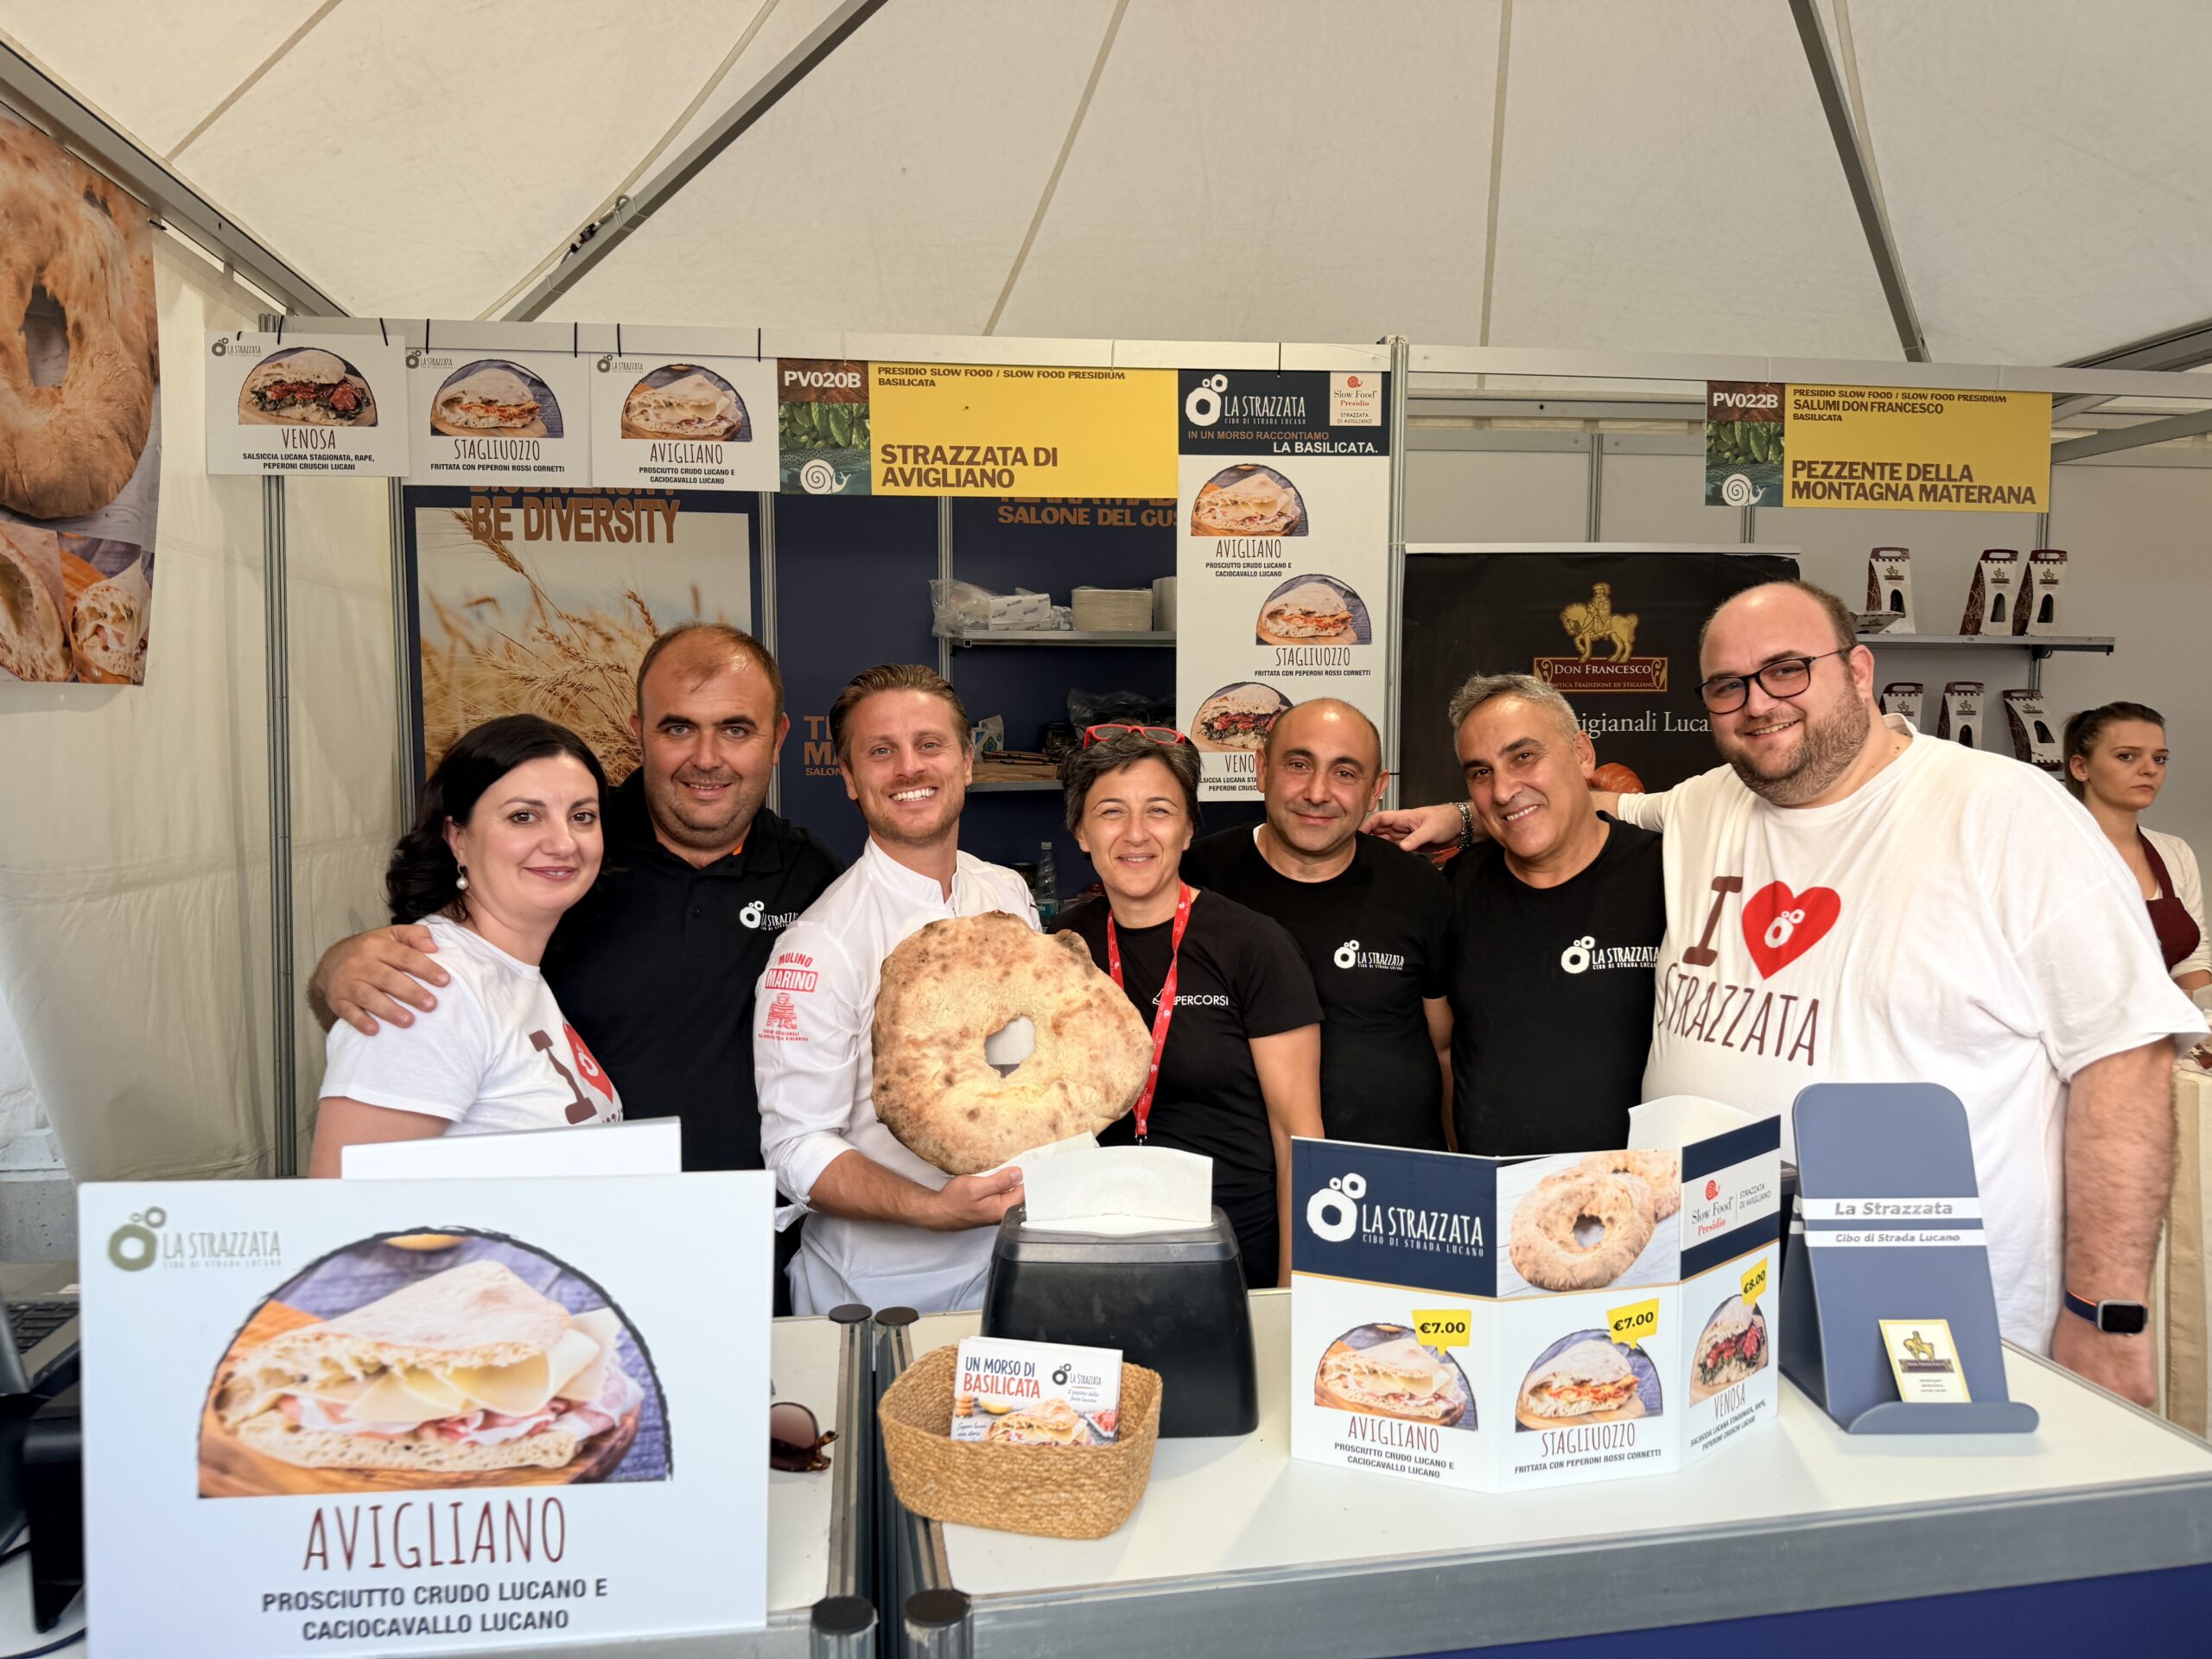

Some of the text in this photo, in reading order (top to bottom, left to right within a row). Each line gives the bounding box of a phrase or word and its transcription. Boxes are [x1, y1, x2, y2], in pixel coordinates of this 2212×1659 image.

[784, 371, 861, 389] PV020B
[878, 366, 1125, 380] PRESIDIO SLOW FOOD / SLOW FOOD PRESIDIUM
[878, 378, 936, 387] BASILICATA
[1334, 390, 1352, 398] Slow
[1713, 392, 1778, 409] PV022B
[1793, 389, 1836, 397] PRESIDIO
[1868, 391, 1893, 399] FOOD
[1895, 391, 1899, 400] /
[1901, 392, 1928, 401] SLOW
[1930, 393, 1955, 402] FOOD
[1957, 394, 2007, 403] PRESIDIUM
[1224, 396, 1306, 417] LA STRAZZATA
[1793, 399, 1944, 415] SALUMI DON FRANCESCO
[1793, 413, 1843, 423] BASILICATA
[282, 429, 336, 450] VENOSA
[1217, 431, 1253, 440] MORSO
[1256, 431, 1329, 441] RACCONTIAMO
[309, 454, 353, 462] STAGIONATA,
[454, 439, 540, 461] STAGLIUOZZO
[650, 442, 723, 465] AVIGLIANO
[880, 444, 1058, 467] STRAZZATA DI
[1273, 442, 1378, 454] LA BASILICATA.
[881, 467, 1015, 489] AVIGLIANO
[1792, 460, 1974, 483] PEZZENTE DELLA
[1791, 481, 2037, 505] MONTAGNA MATERANA
[470, 496, 681, 543] BE DIVERSITY
[997, 506, 1137, 526] SALONE DEL
[1216, 539, 1281, 558] AVIGLIANO
[1275, 647, 1351, 666] STAGLIUOZZO
[1554, 664, 1651, 674] DON FRANCESCO
[1224, 754, 1255, 772] VENO
[1681, 876, 1743, 967] I
[779, 952, 813, 968] MULINO
[1357, 952, 1404, 967] LA STRAZZATA
[1592, 946, 1659, 964] LA STRAZZATA
[766, 969, 816, 991] MARINO
[1657, 963, 1819, 1066] STRAZZATA
[1692, 1208, 1712, 1225] Slow
[1834, 1202, 1953, 1216] La Strazzata
[1363, 1204, 1484, 1246] LA STRAZZATA
[1697, 1217, 1726, 1236] Presidio
[162, 1231, 281, 1259] LA STRAZZATA
[1363, 1234, 1484, 1257] CIBO DI STRADA LUCANO
[1836, 1233, 1960, 1243] Cibo di Strada Lucano
[1743, 1269, 1766, 1294] €8.00
[1420, 1322, 1465, 1333] €7.00
[1613, 1311, 1654, 1332] €7.00
[965, 1357, 1035, 1377] UN MORSO DI
[963, 1373, 1040, 1399] BASILICATA
[1714, 1382, 1745, 1420] VENOSA
[1348, 1415, 1439, 1453] AVIGLIANO
[1541, 1422, 1636, 1458] STAGLIUOZZO
[1334, 1442, 1382, 1458] PROSCIUTTO
[1385, 1452, 1412, 1462] CRUDO
[1414, 1456, 1446, 1468] LUCANO
[1515, 1449, 1662, 1474] FRITTATA CON PEPERONI ROSSI CORNETTI
[1347, 1456, 1440, 1478] CACIOCAVALLO LUCANO
[302, 1496, 565, 1572] AVIGLIANO
[262, 1578, 608, 1612] PROSCIUTTO CRUDO LUCANO E
[302, 1609, 569, 1641] CACIOCAVALLO LUCANO
